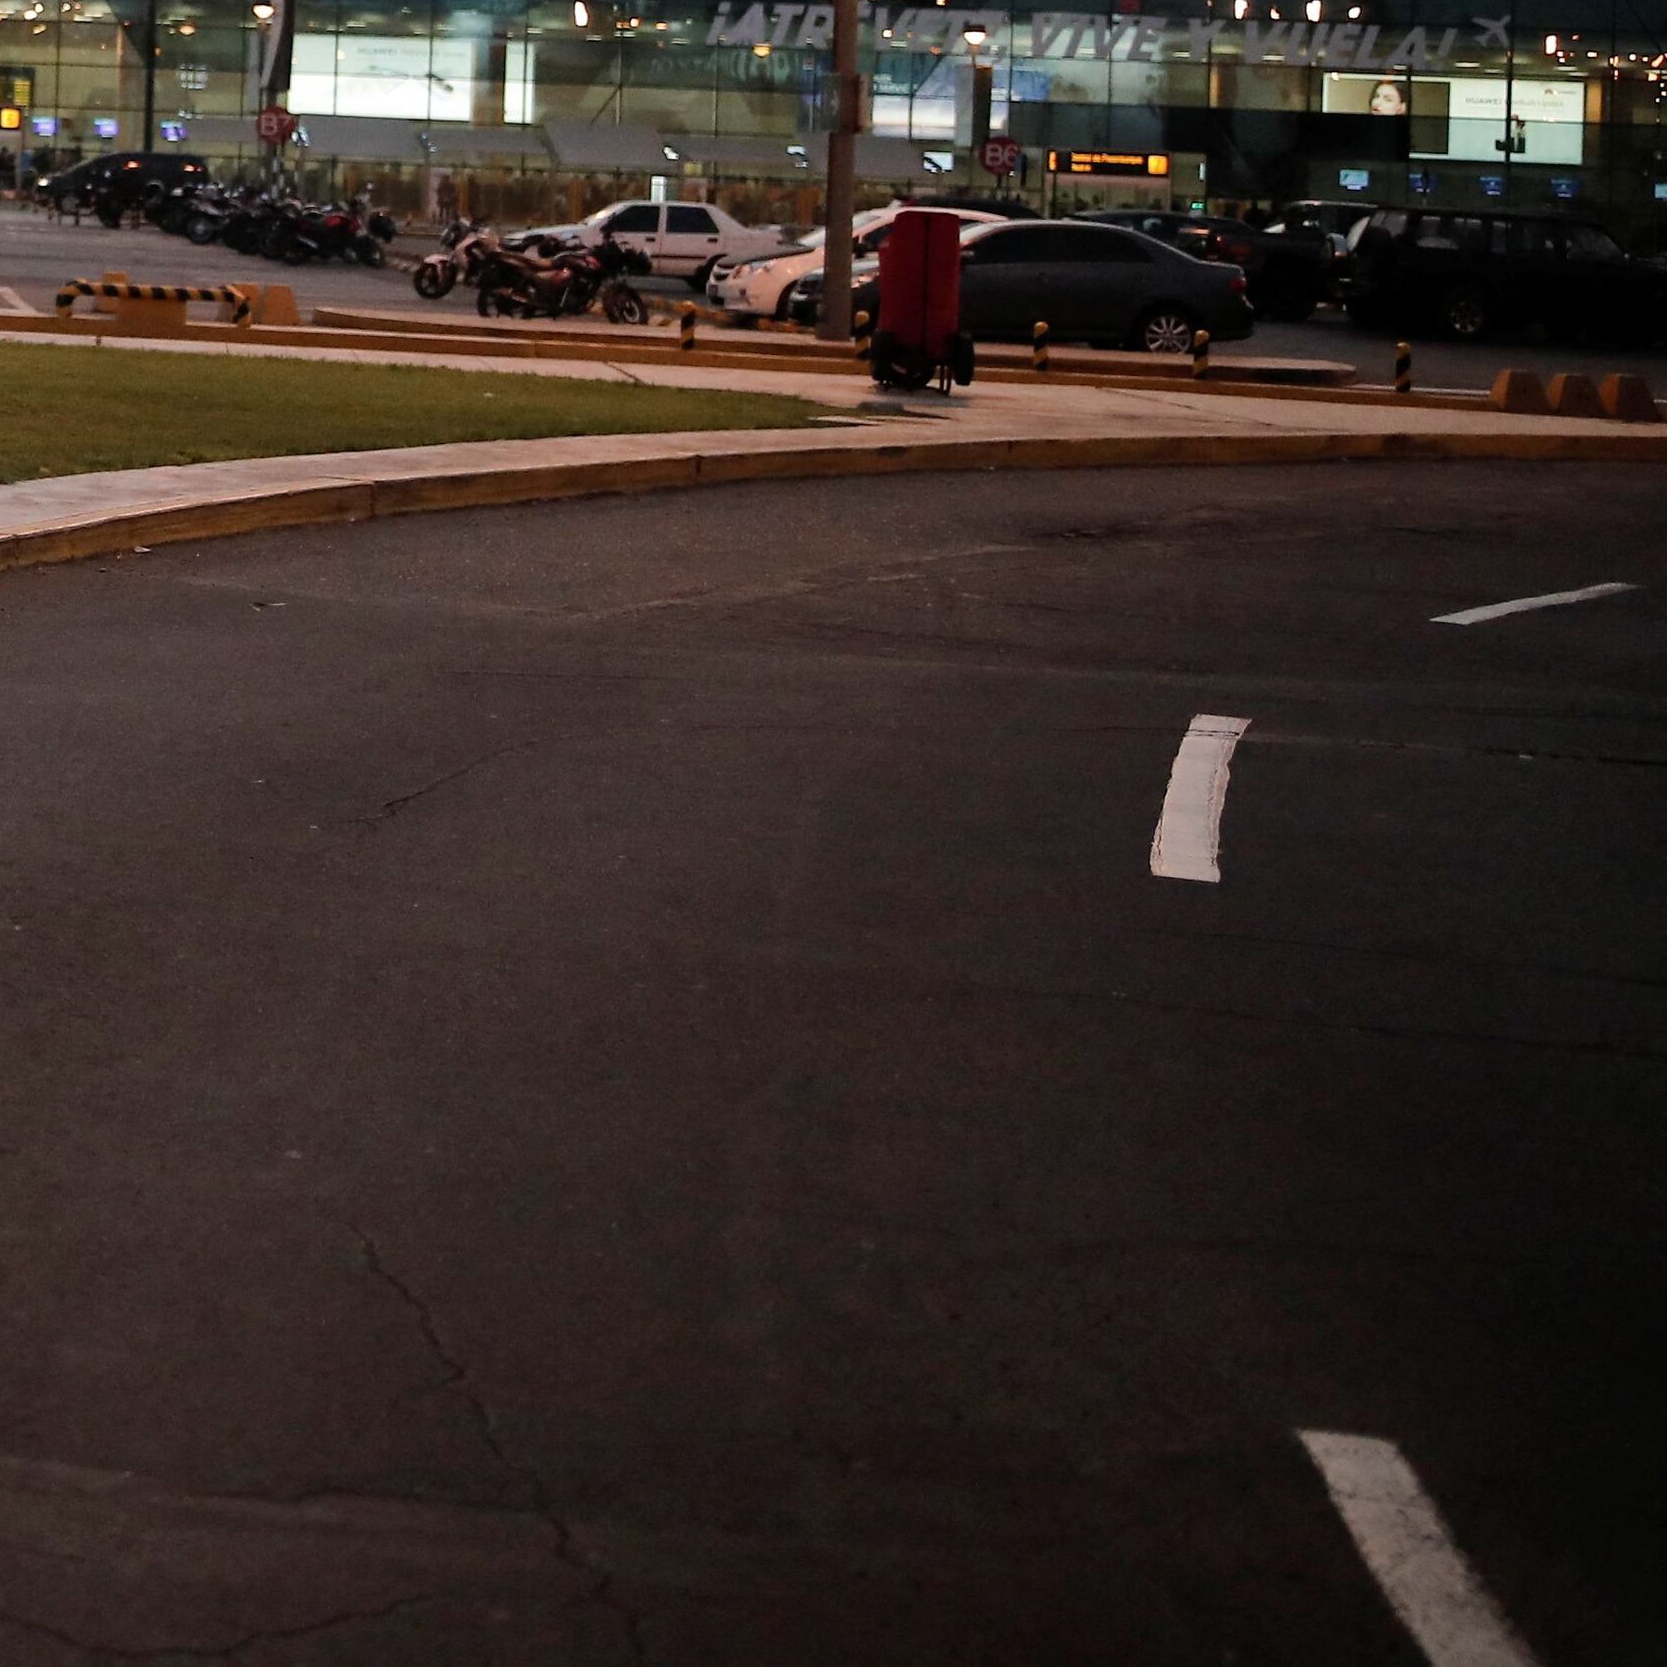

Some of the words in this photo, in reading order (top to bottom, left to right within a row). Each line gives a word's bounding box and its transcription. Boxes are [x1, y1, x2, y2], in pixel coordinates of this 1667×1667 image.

[1029, 11, 1167, 61] VIVE
[1185, 17, 1228, 62] Y
[1246, 20, 1458, 70] VUELA!
